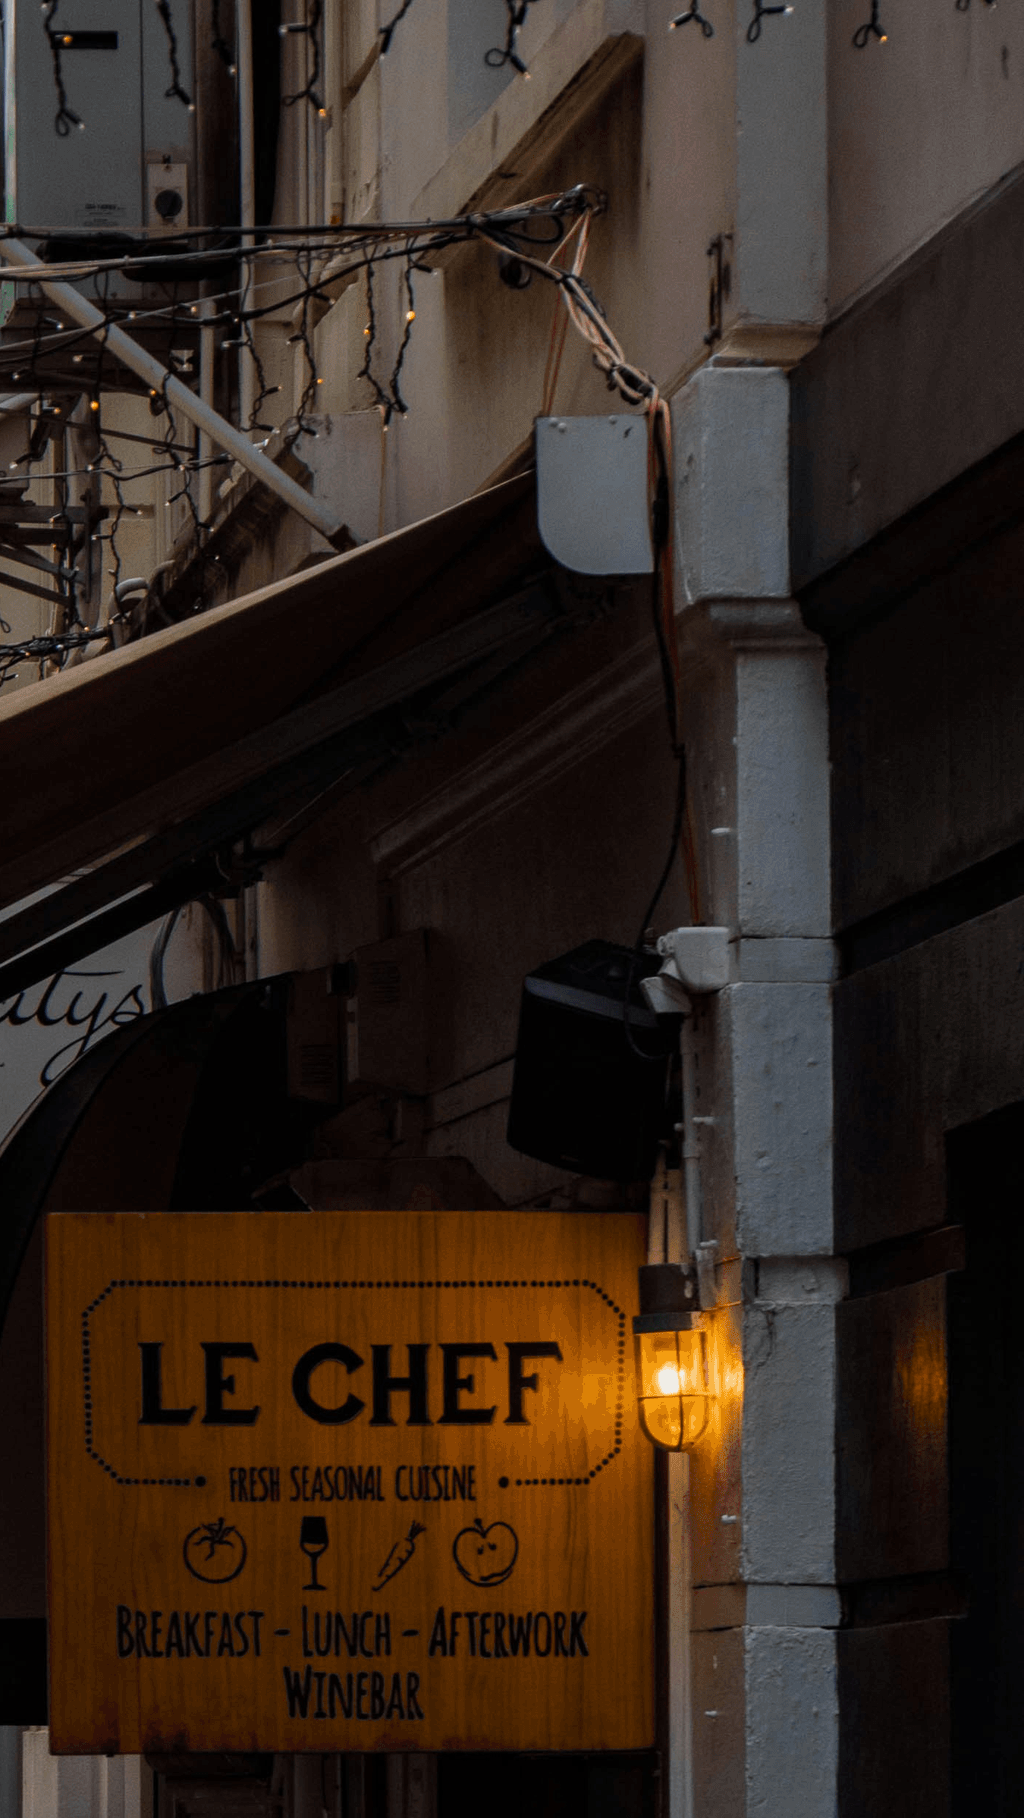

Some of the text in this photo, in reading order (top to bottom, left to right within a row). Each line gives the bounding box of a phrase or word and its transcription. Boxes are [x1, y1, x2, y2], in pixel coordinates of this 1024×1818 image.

[138, 1342, 564, 1426] LE CHEF
[229, 1466, 476, 1501] FRESH SEASONAL CUISINE
[116, 1605, 264, 1658] BREAKFAST
[302, 1605, 391, 1657] LUNCH
[429, 1606, 589, 1658] AFTERWORK
[283, 1665, 424, 1720] WINEBAR
